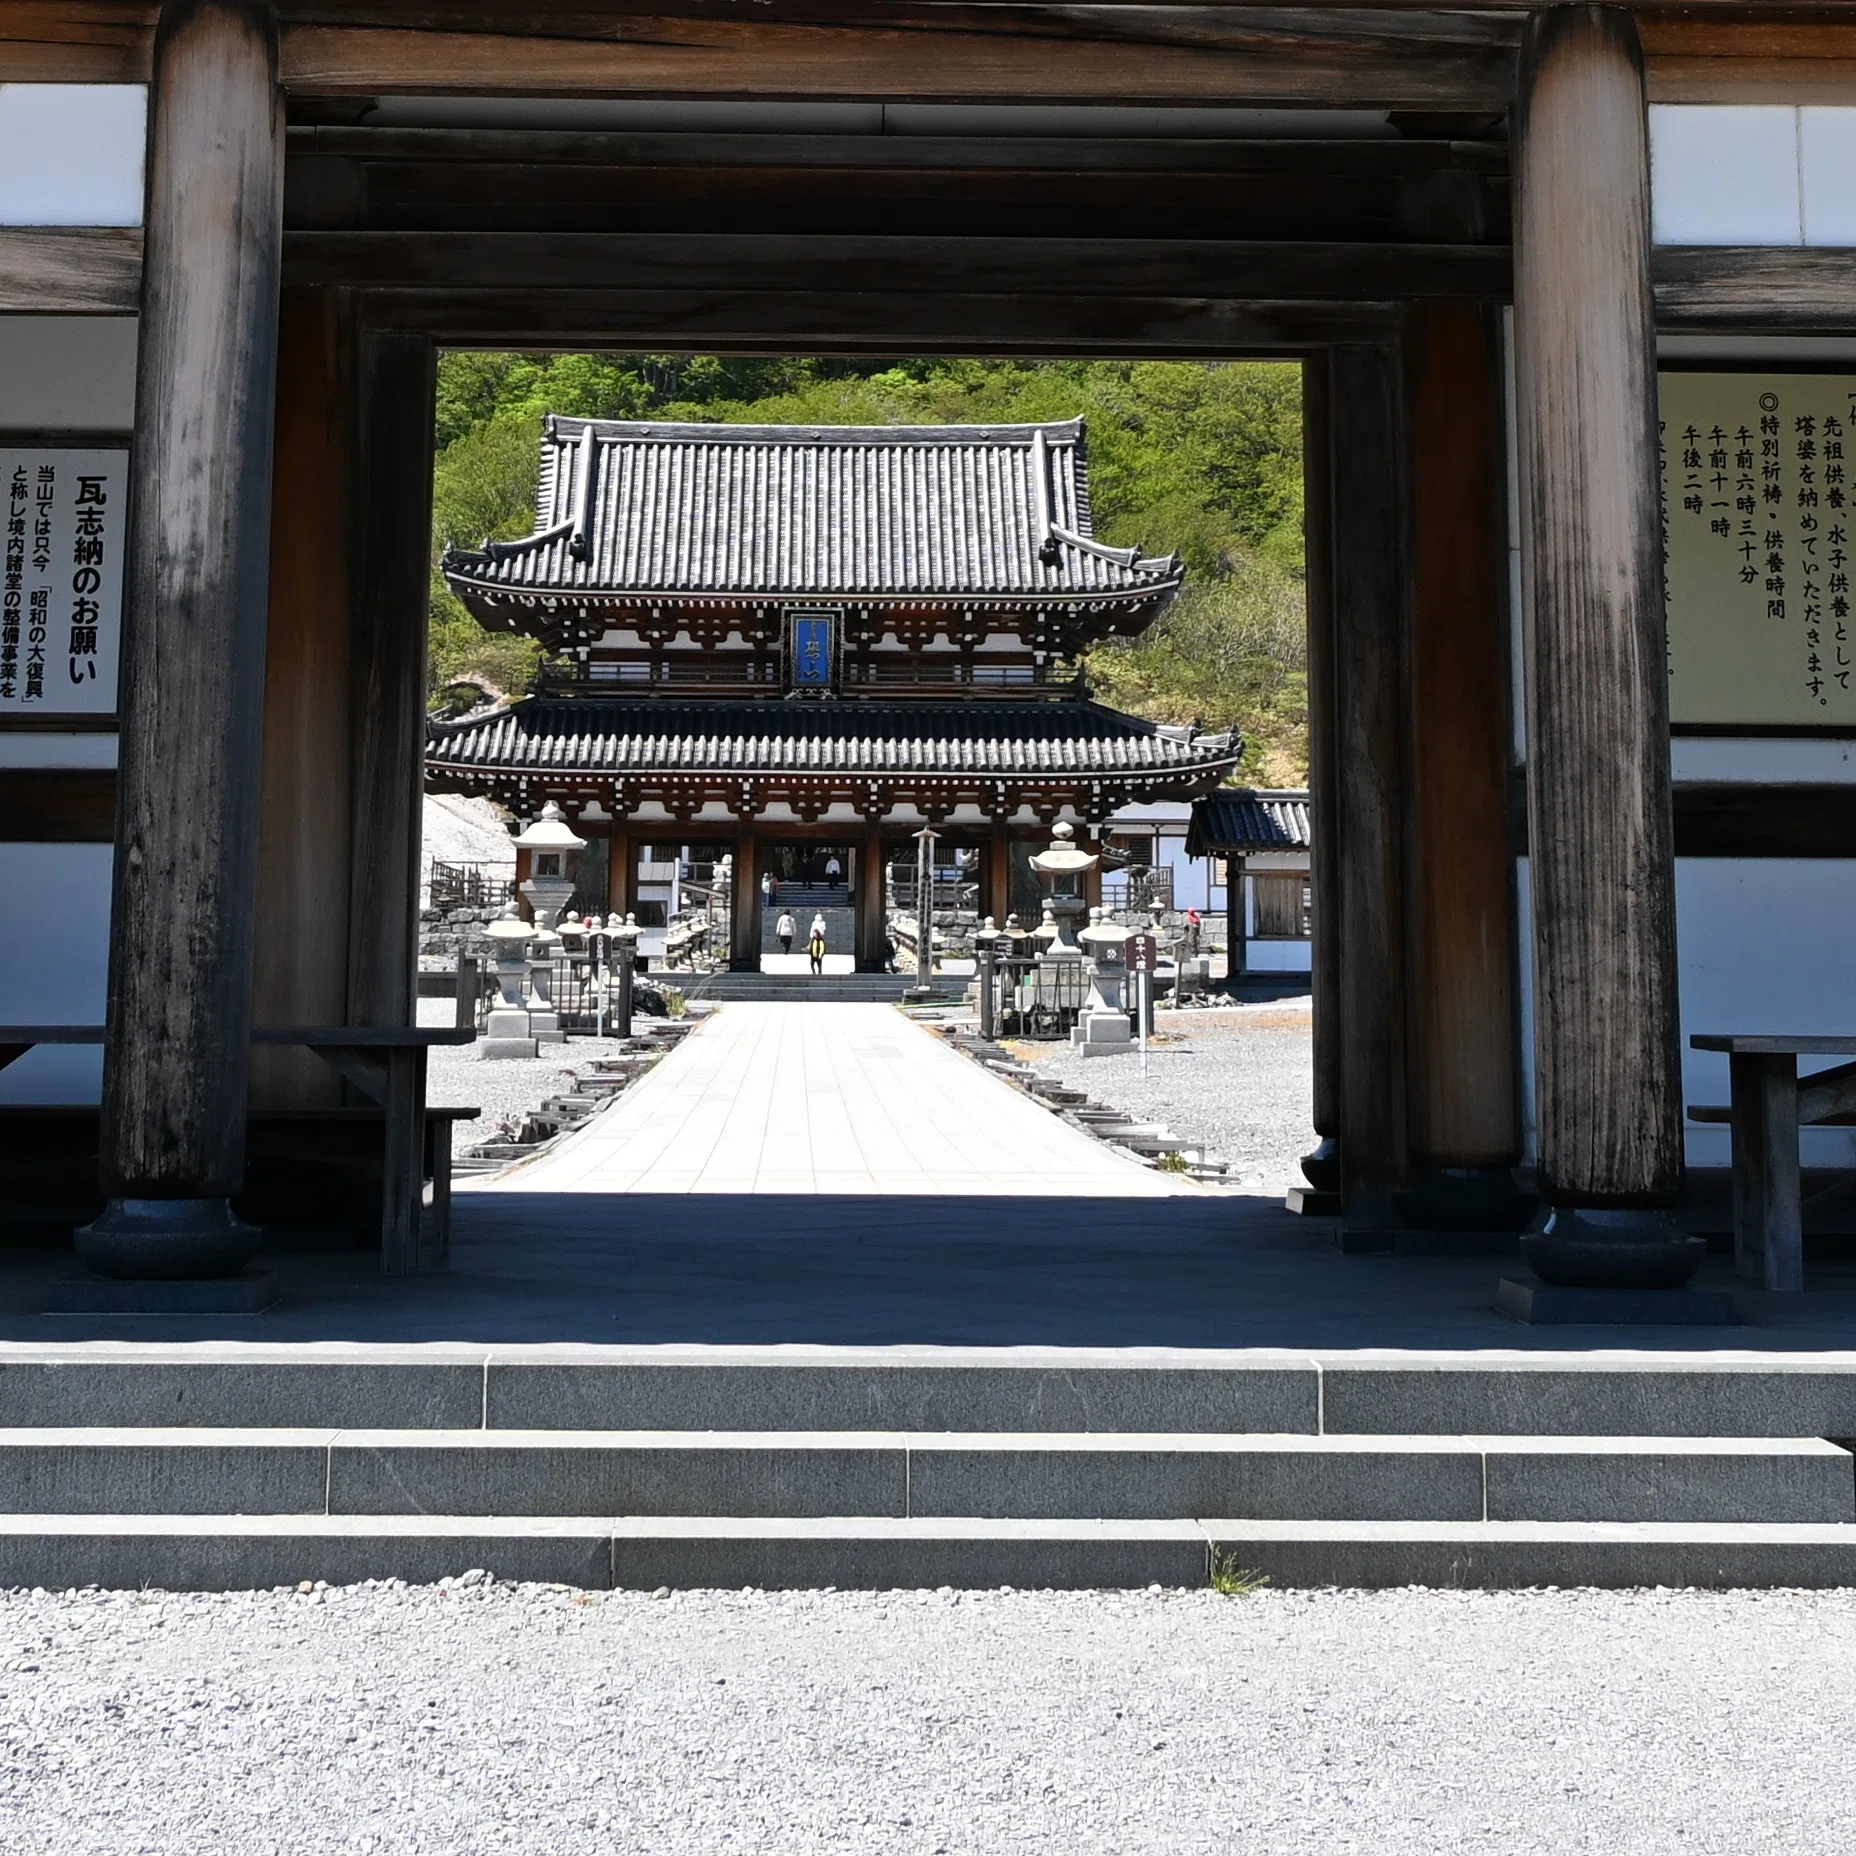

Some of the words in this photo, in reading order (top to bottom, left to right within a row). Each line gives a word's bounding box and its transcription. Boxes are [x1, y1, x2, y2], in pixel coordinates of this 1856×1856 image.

[1681, 425, 1703, 515] 午後二時
[1708, 426, 1731, 538] 午前十一時
[1734, 426, 1759, 584] 午前六時三十分
[1794, 416, 1827, 705] 塔婆を納めていただきます。
[1822, 417, 1851, 689] 先祖供養、水子供養として
[0, 466, 28, 698] と称し境内諸堂の整備事業を
[69, 476, 107, 684] 瓦志納のお願い
